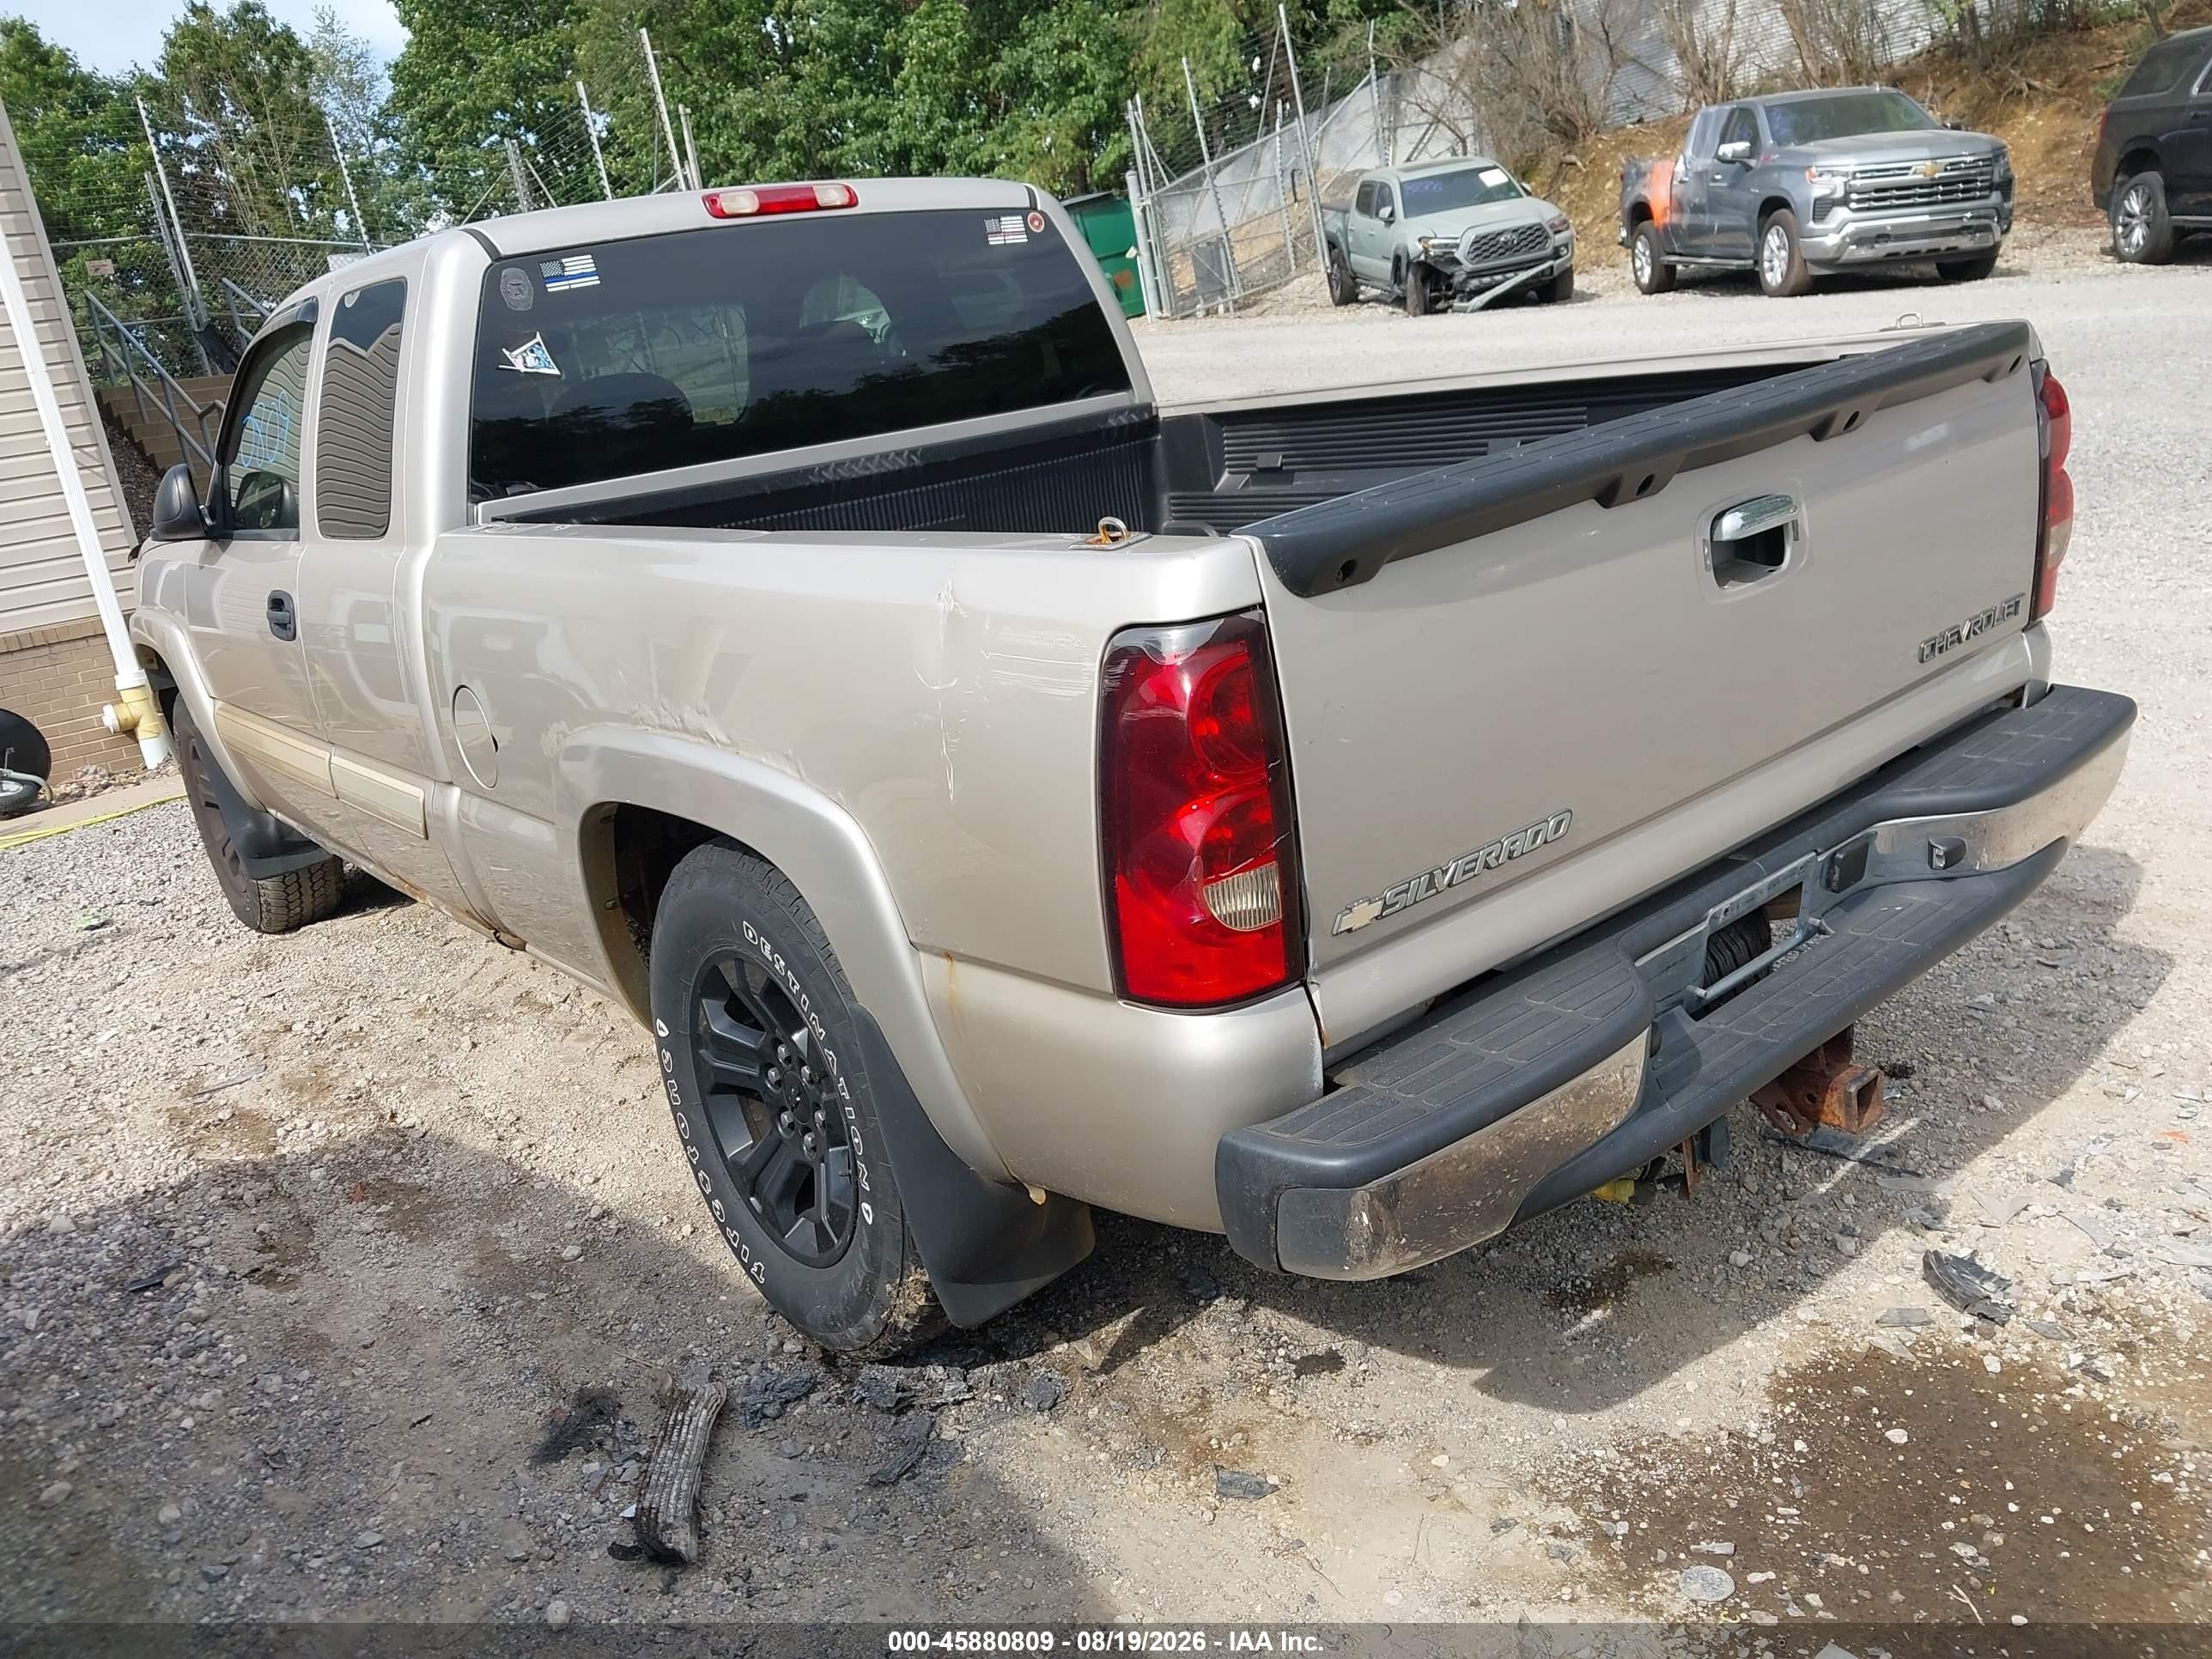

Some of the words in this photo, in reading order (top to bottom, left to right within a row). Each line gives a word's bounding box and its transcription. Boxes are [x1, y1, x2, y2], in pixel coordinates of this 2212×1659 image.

[1918, 592, 2026, 664] CHEVROLET
[1382, 808, 1573, 920] SILVERADO
[742, 920, 871, 1193] DESTINATION
[660, 1047, 765, 1285] FIRESTONE
